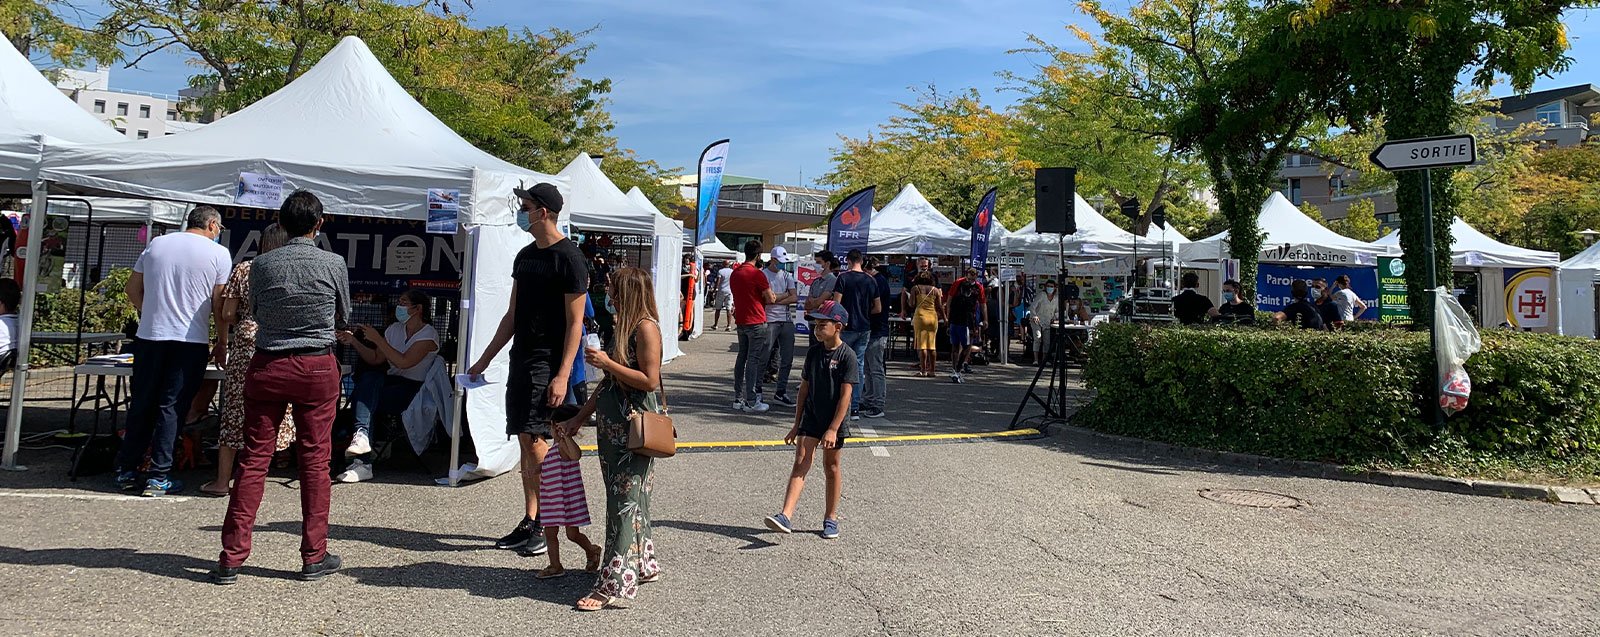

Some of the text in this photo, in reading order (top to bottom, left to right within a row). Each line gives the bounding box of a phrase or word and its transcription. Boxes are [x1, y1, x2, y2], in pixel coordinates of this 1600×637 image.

[1410, 144, 1467, 160] SORTIE
[839, 230, 860, 239] FFR
[1264, 243, 1347, 263] Villefontaine
[1256, 293, 1281, 306] Saint
